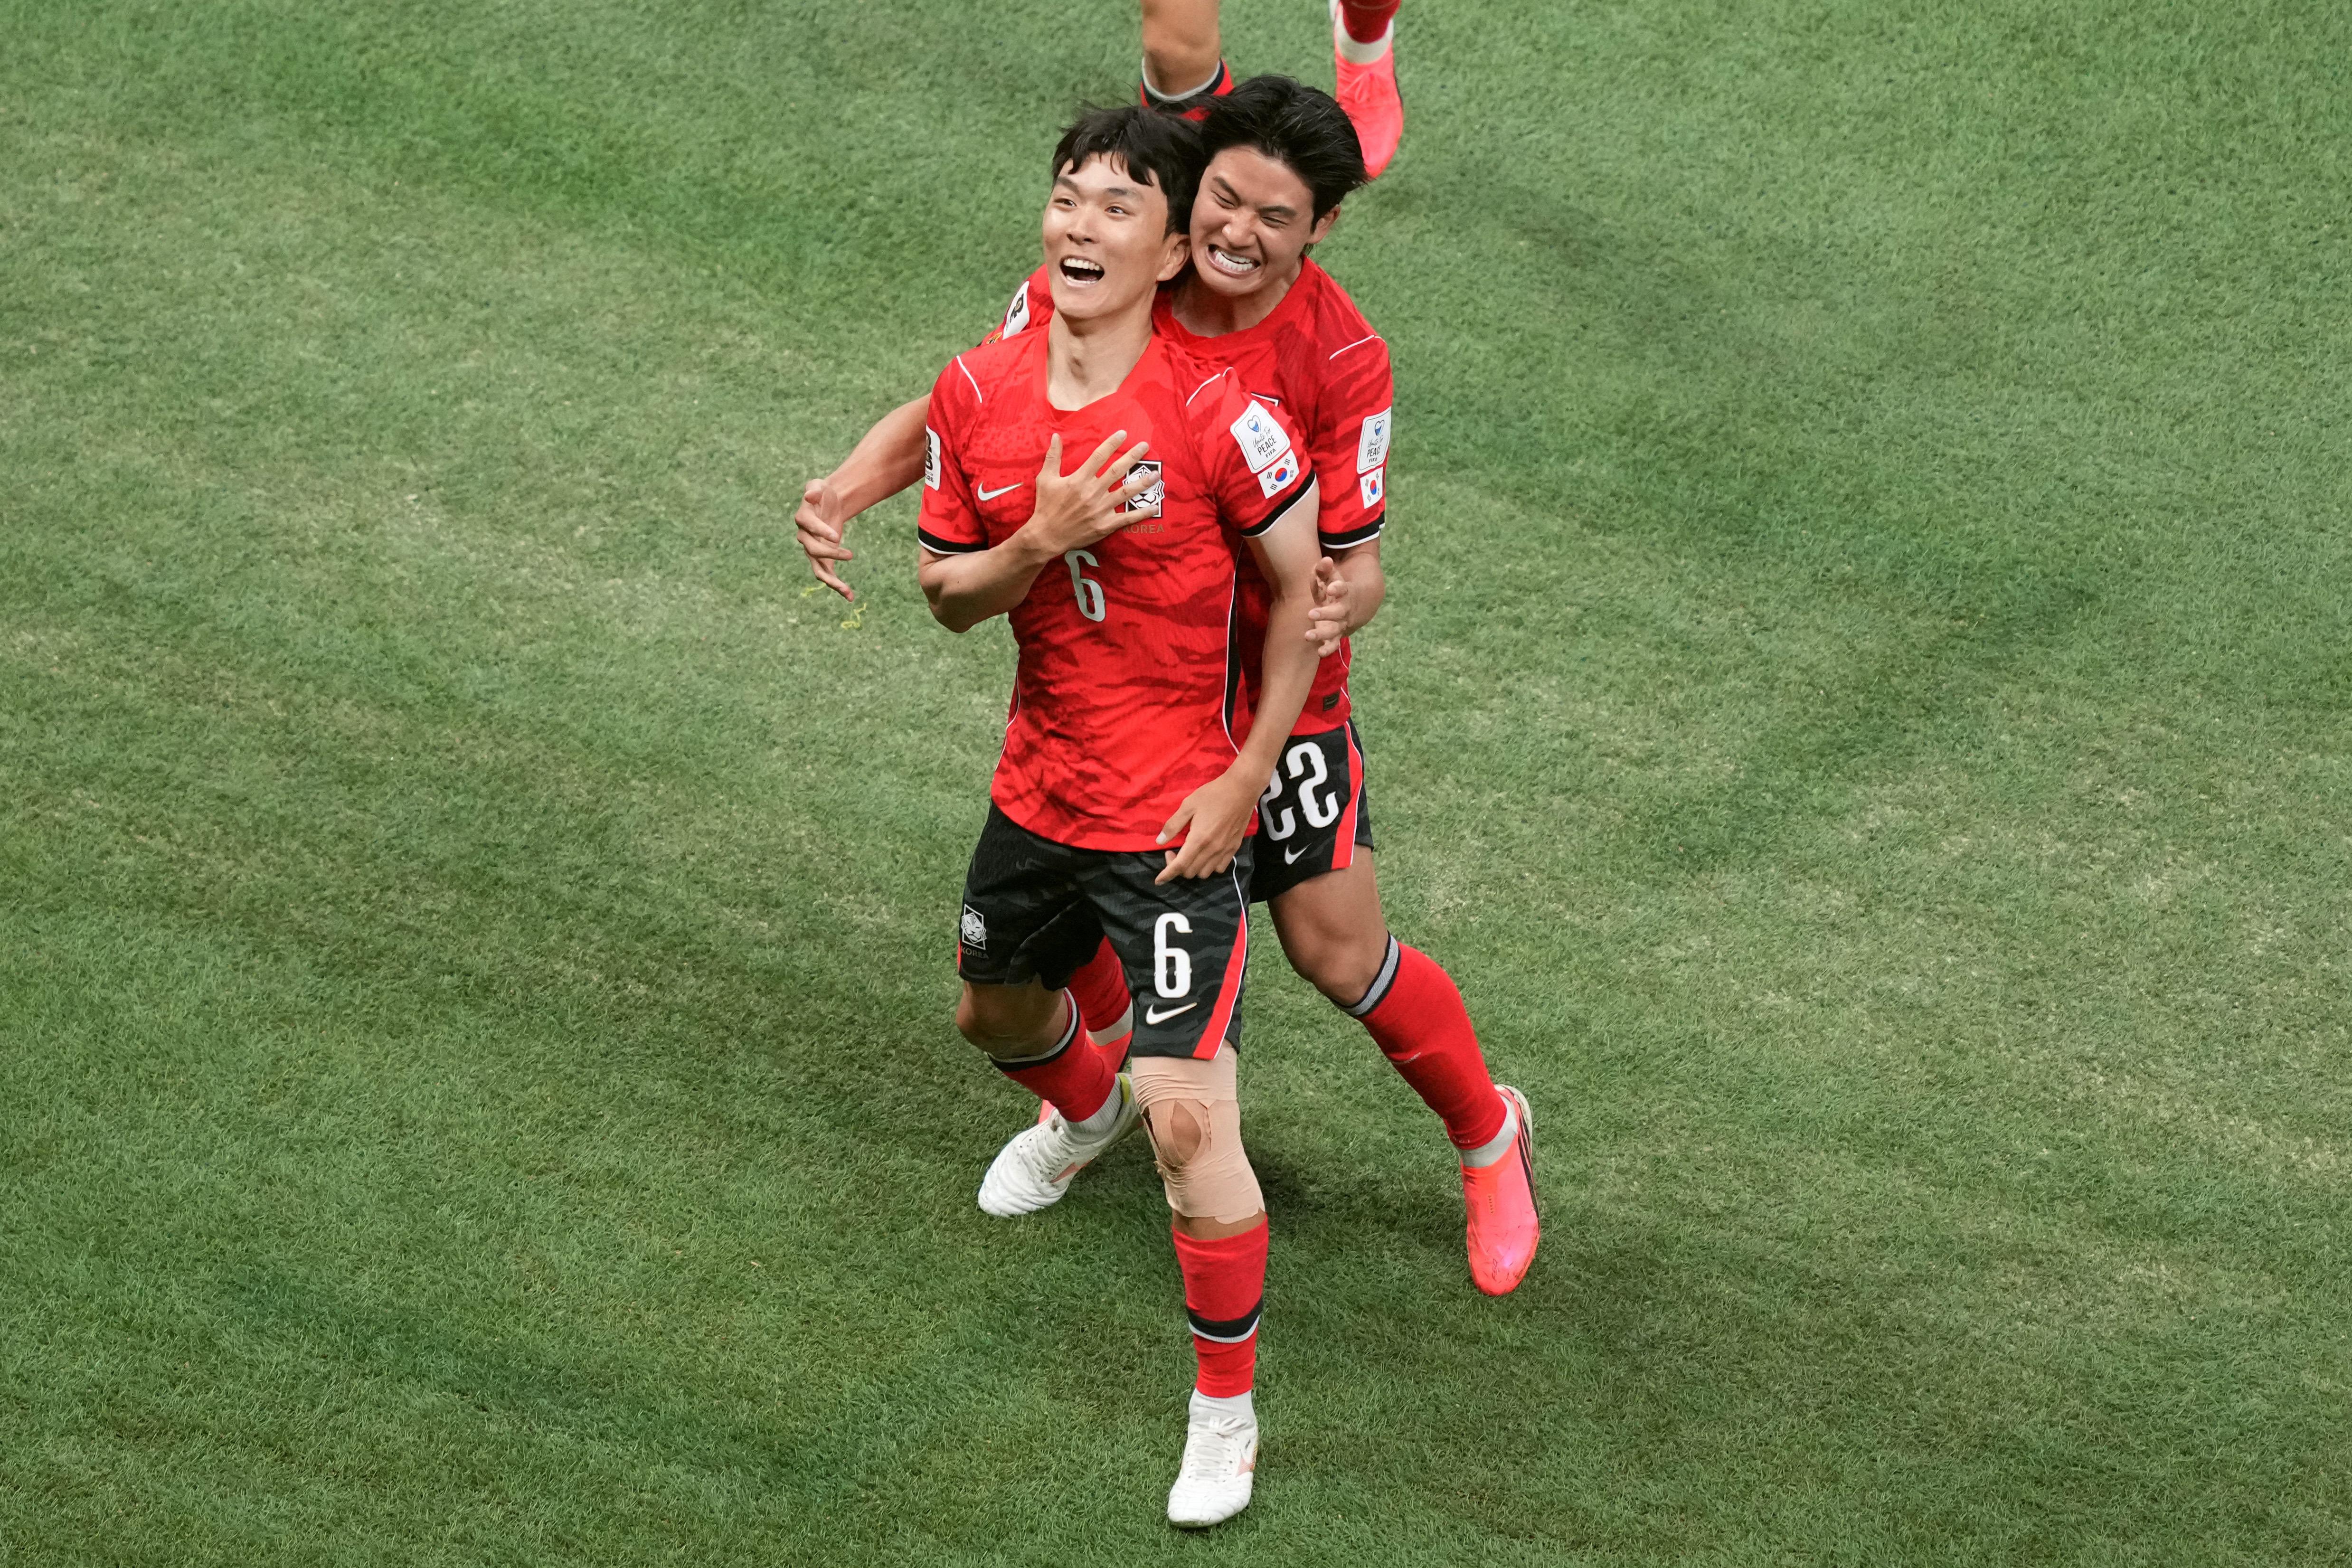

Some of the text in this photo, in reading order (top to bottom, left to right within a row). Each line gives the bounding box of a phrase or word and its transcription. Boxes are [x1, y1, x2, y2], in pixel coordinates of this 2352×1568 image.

[1257, 435, 1277, 455] PEACE
[1265, 448, 1276, 458] FIFA
[1065, 550, 1106, 622] 6
[1260, 742, 1339, 841] 22
[1154, 912, 1193, 999] 6
